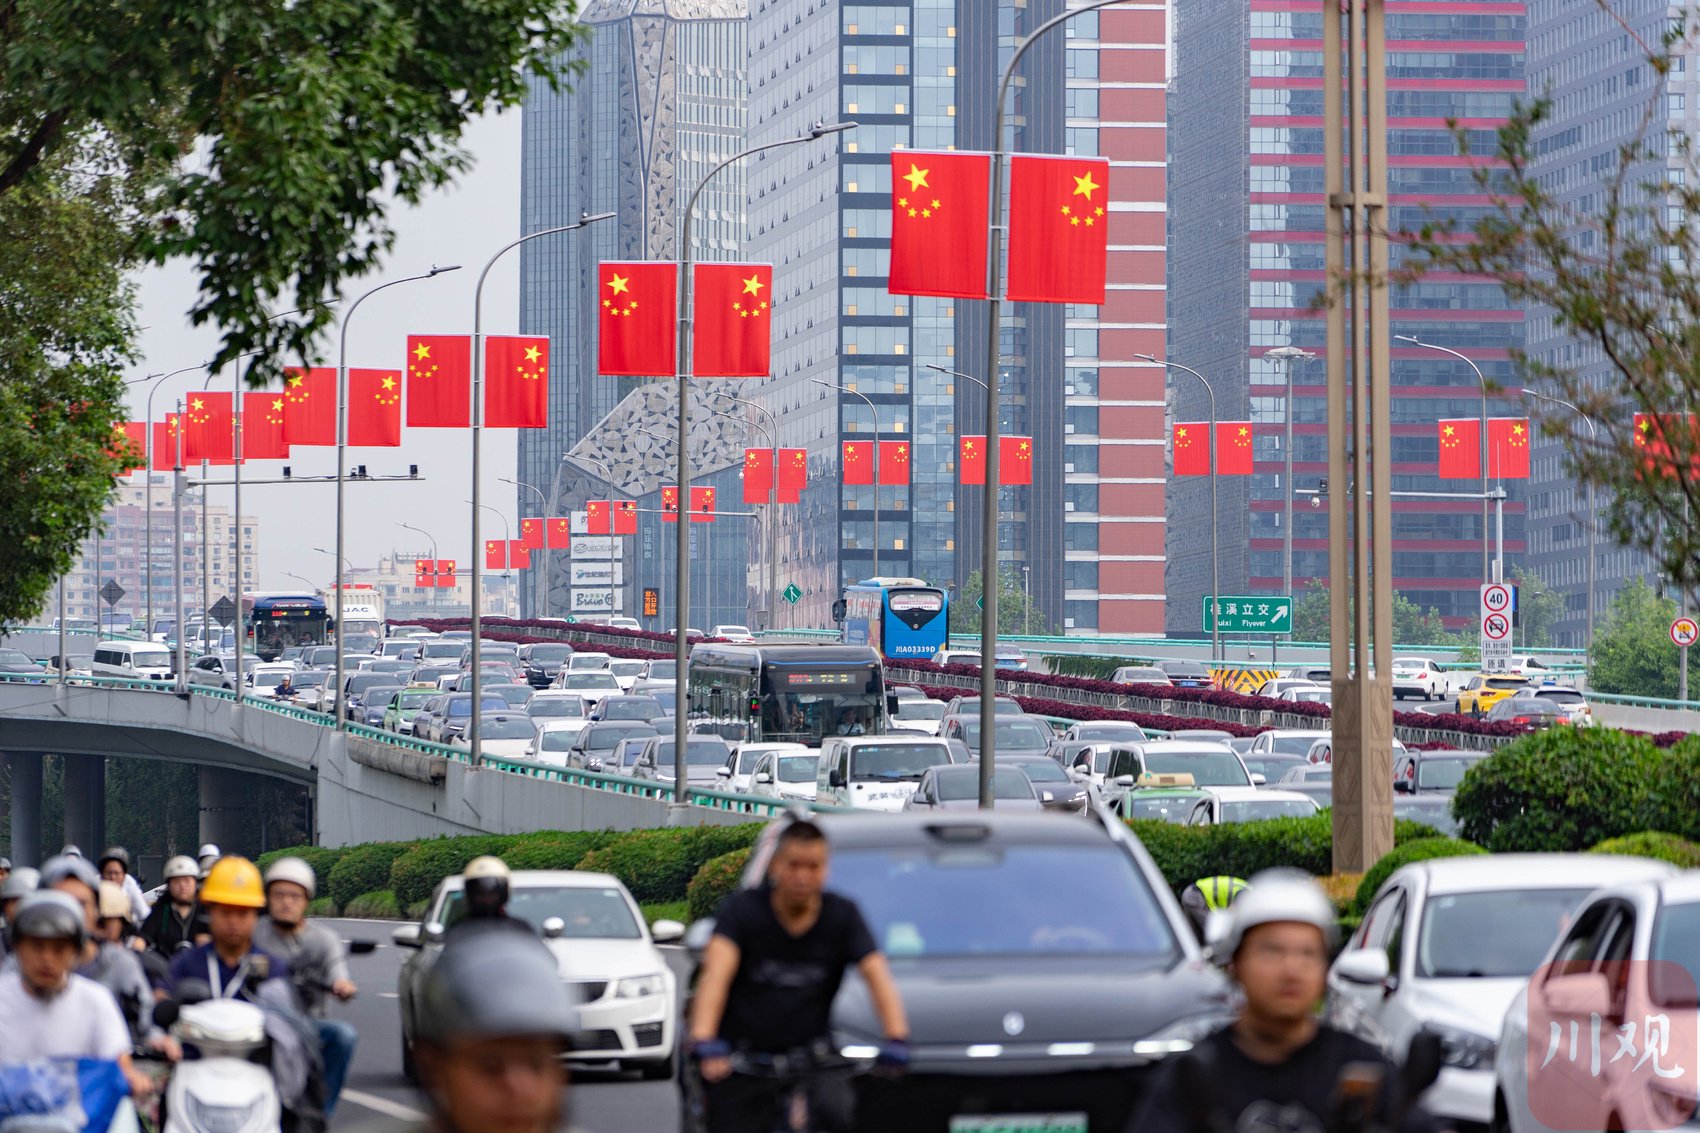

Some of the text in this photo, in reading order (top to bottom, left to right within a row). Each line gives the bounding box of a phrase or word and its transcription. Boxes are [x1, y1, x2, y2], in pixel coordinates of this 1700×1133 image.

[576, 593, 604, 606] Bravo
[1489, 593, 1503, 605] 40
[1242, 619, 1266, 628] Flyover
